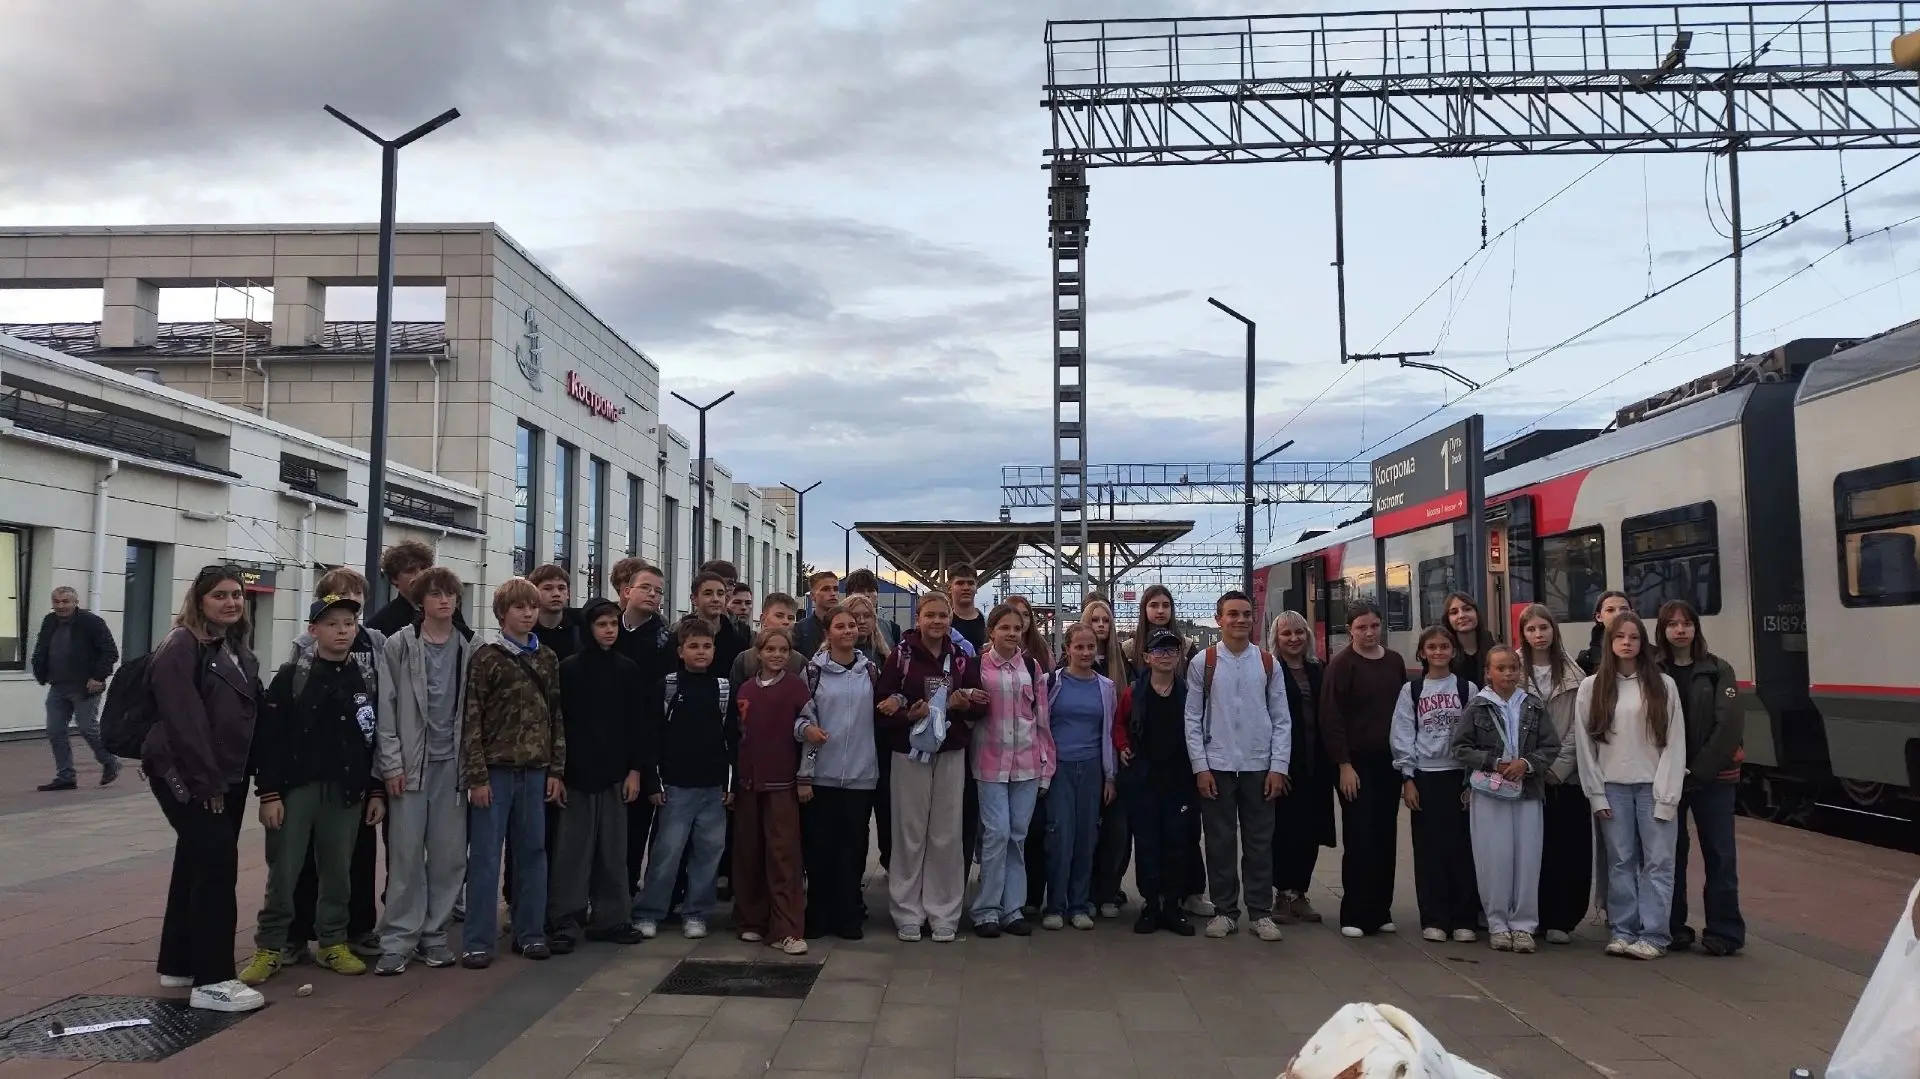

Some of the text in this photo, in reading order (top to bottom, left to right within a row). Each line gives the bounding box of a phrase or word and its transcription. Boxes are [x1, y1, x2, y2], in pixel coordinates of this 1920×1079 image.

[567, 370, 620, 422] Кострома
[1449, 438, 1462, 452] Путь
[1375, 457, 1415, 487] Кострома
[1441, 440, 1449, 491] 1
[1376, 492, 1404, 512] Kostroma
